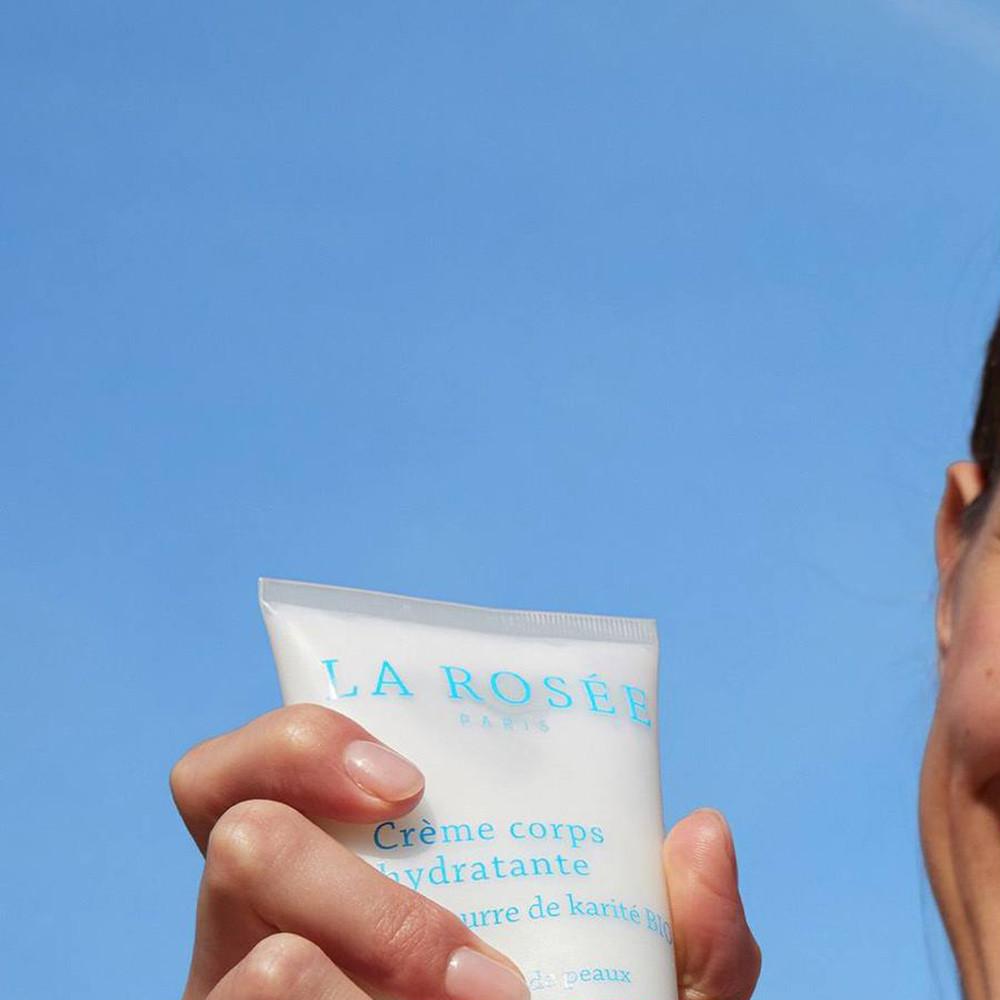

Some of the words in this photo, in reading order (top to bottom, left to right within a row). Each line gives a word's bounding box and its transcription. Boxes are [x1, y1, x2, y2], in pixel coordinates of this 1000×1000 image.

[322, 658, 414, 700] LA
[440, 664, 652, 729] ROSÉE
[459, 713, 550, 733] PARIS
[373, 819, 495, 850] Crème
[509, 821, 604, 848] corps
[460, 905, 519, 928] urre
[528, 894, 560, 919] de
[566, 893, 641, 925] karité
[563, 967, 631, 990] peaux
